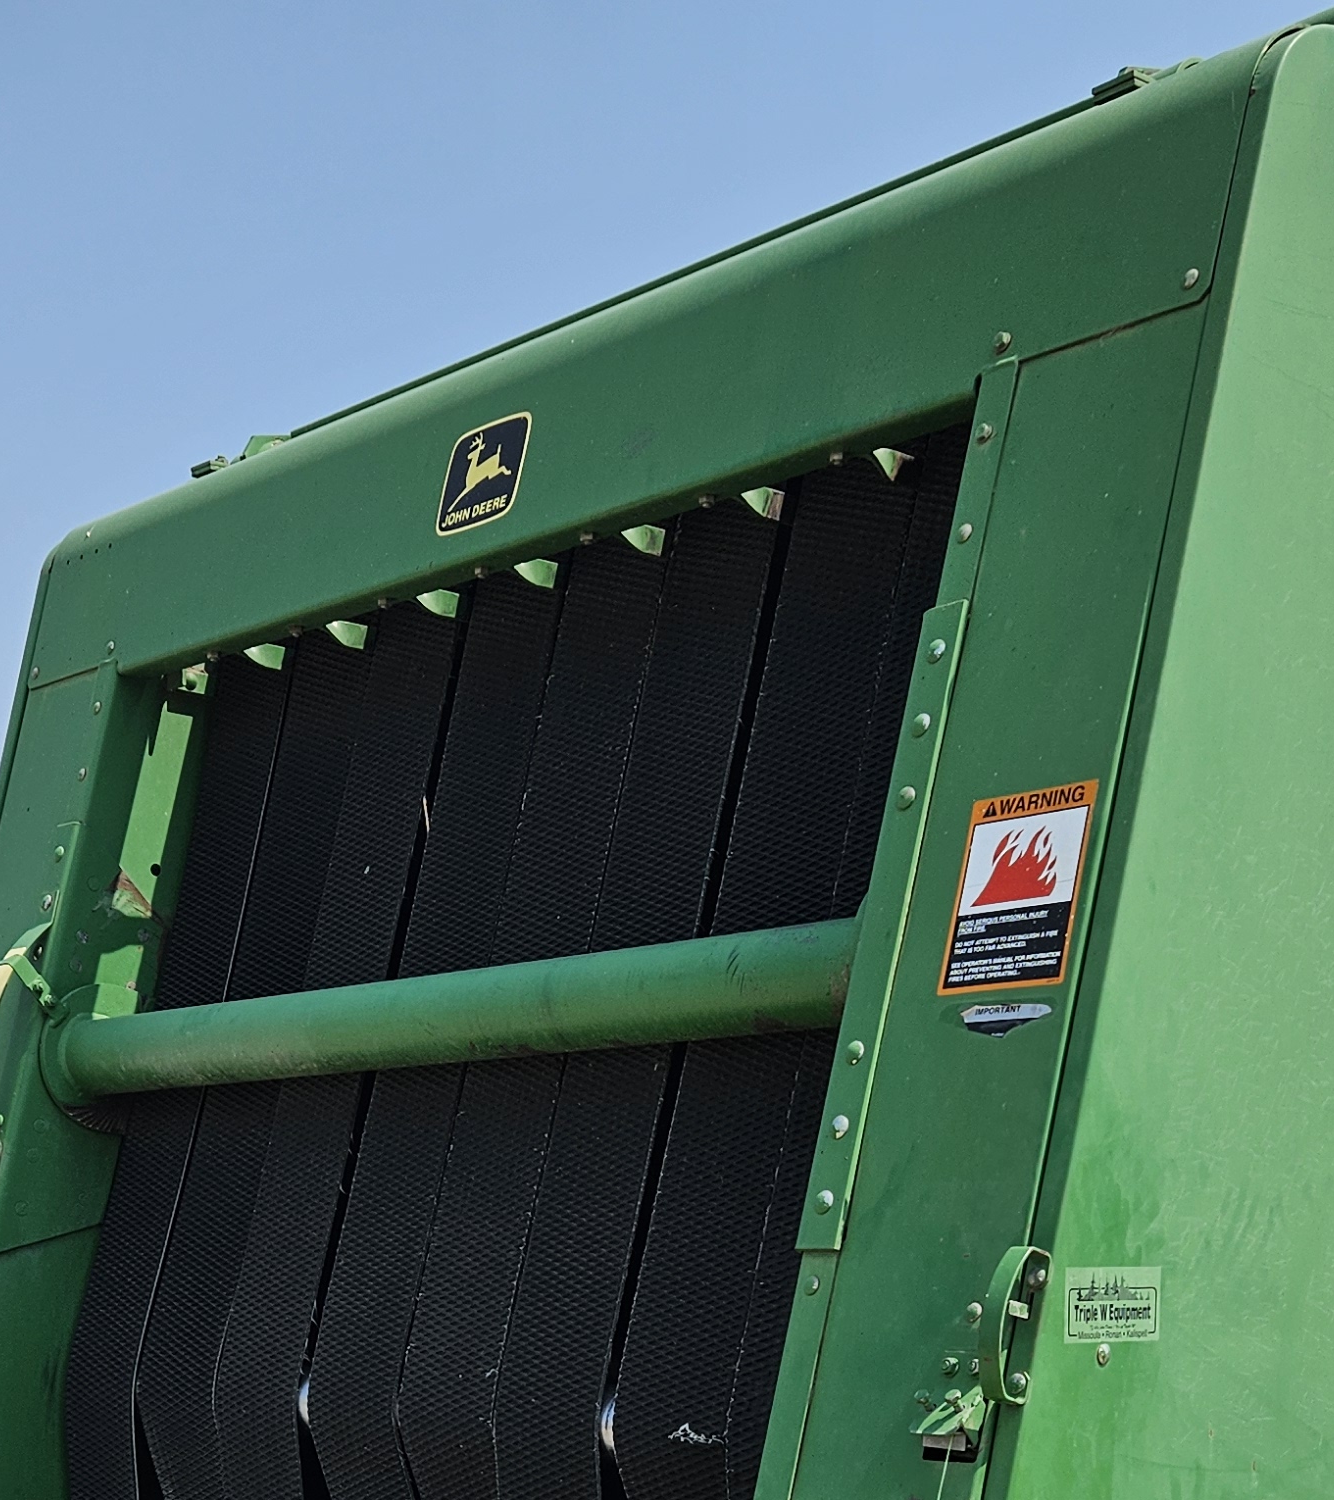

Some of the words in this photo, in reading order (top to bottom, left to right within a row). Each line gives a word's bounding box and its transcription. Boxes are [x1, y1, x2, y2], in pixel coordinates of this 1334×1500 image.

[441, 507, 471, 528] JOHN
[471, 494, 507, 518] DEERE
[1000, 785, 1086, 816] WARNING
[975, 1005, 1021, 1016] IMPORTANT
[1074, 1304, 1097, 1324] Triple
[1099, 1304, 1107, 1320] W
[1109, 1303, 1151, 1323] Equipment
